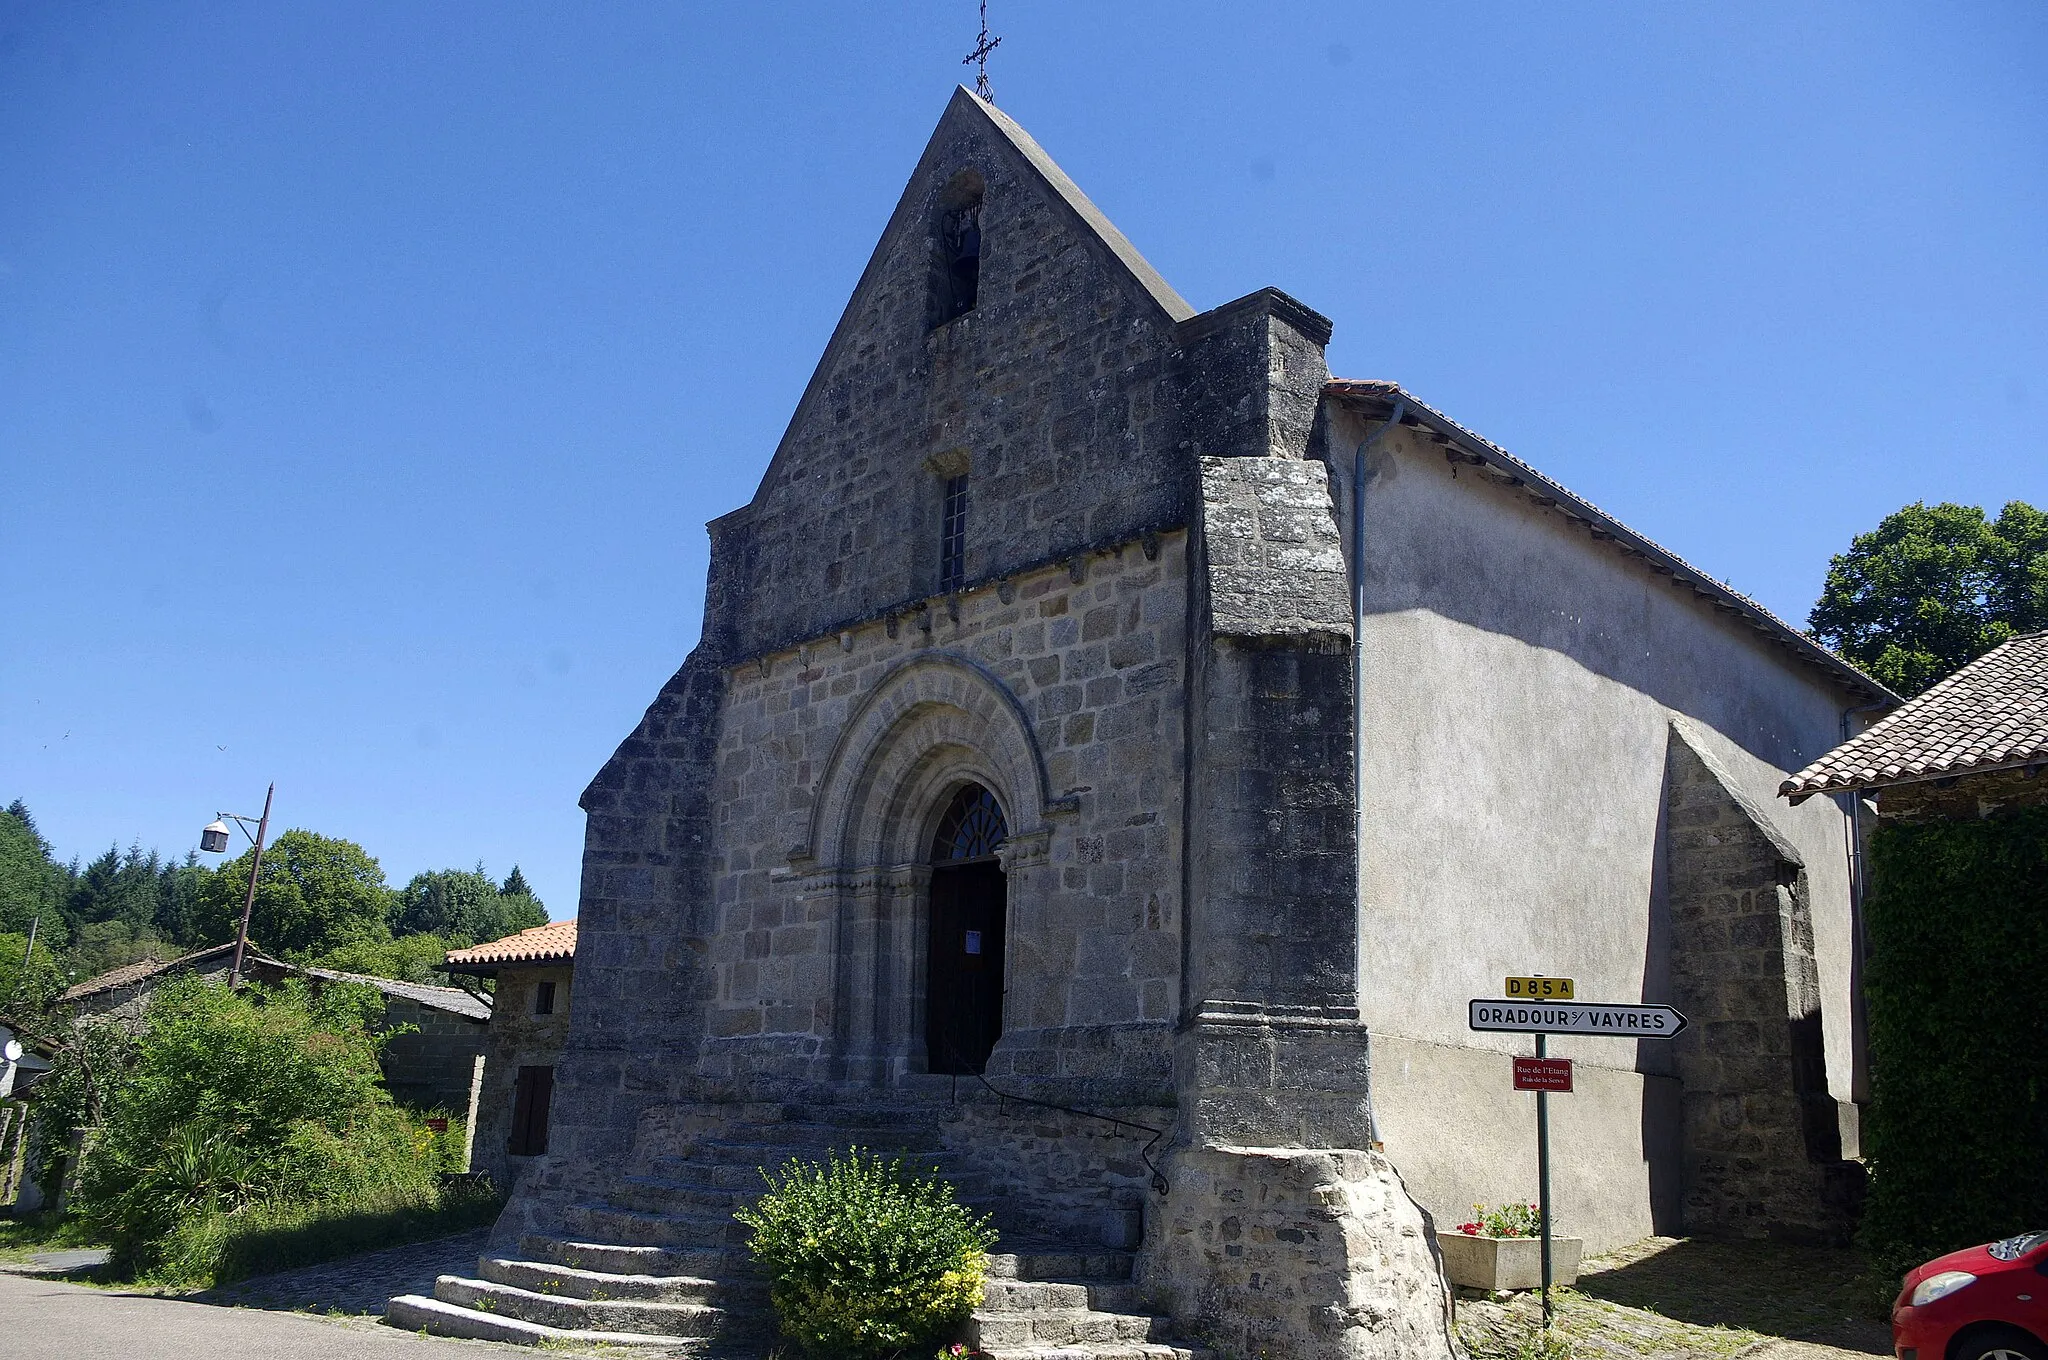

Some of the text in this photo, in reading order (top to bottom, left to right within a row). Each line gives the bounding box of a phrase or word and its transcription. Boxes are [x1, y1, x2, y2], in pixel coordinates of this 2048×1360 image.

[1510, 980, 1569, 995] D 85 A
[1479, 1008, 1569, 1026] ORADOUR
[1588, 1011, 1665, 1029] VAYRES
[1532, 1066, 1542, 1074] de
